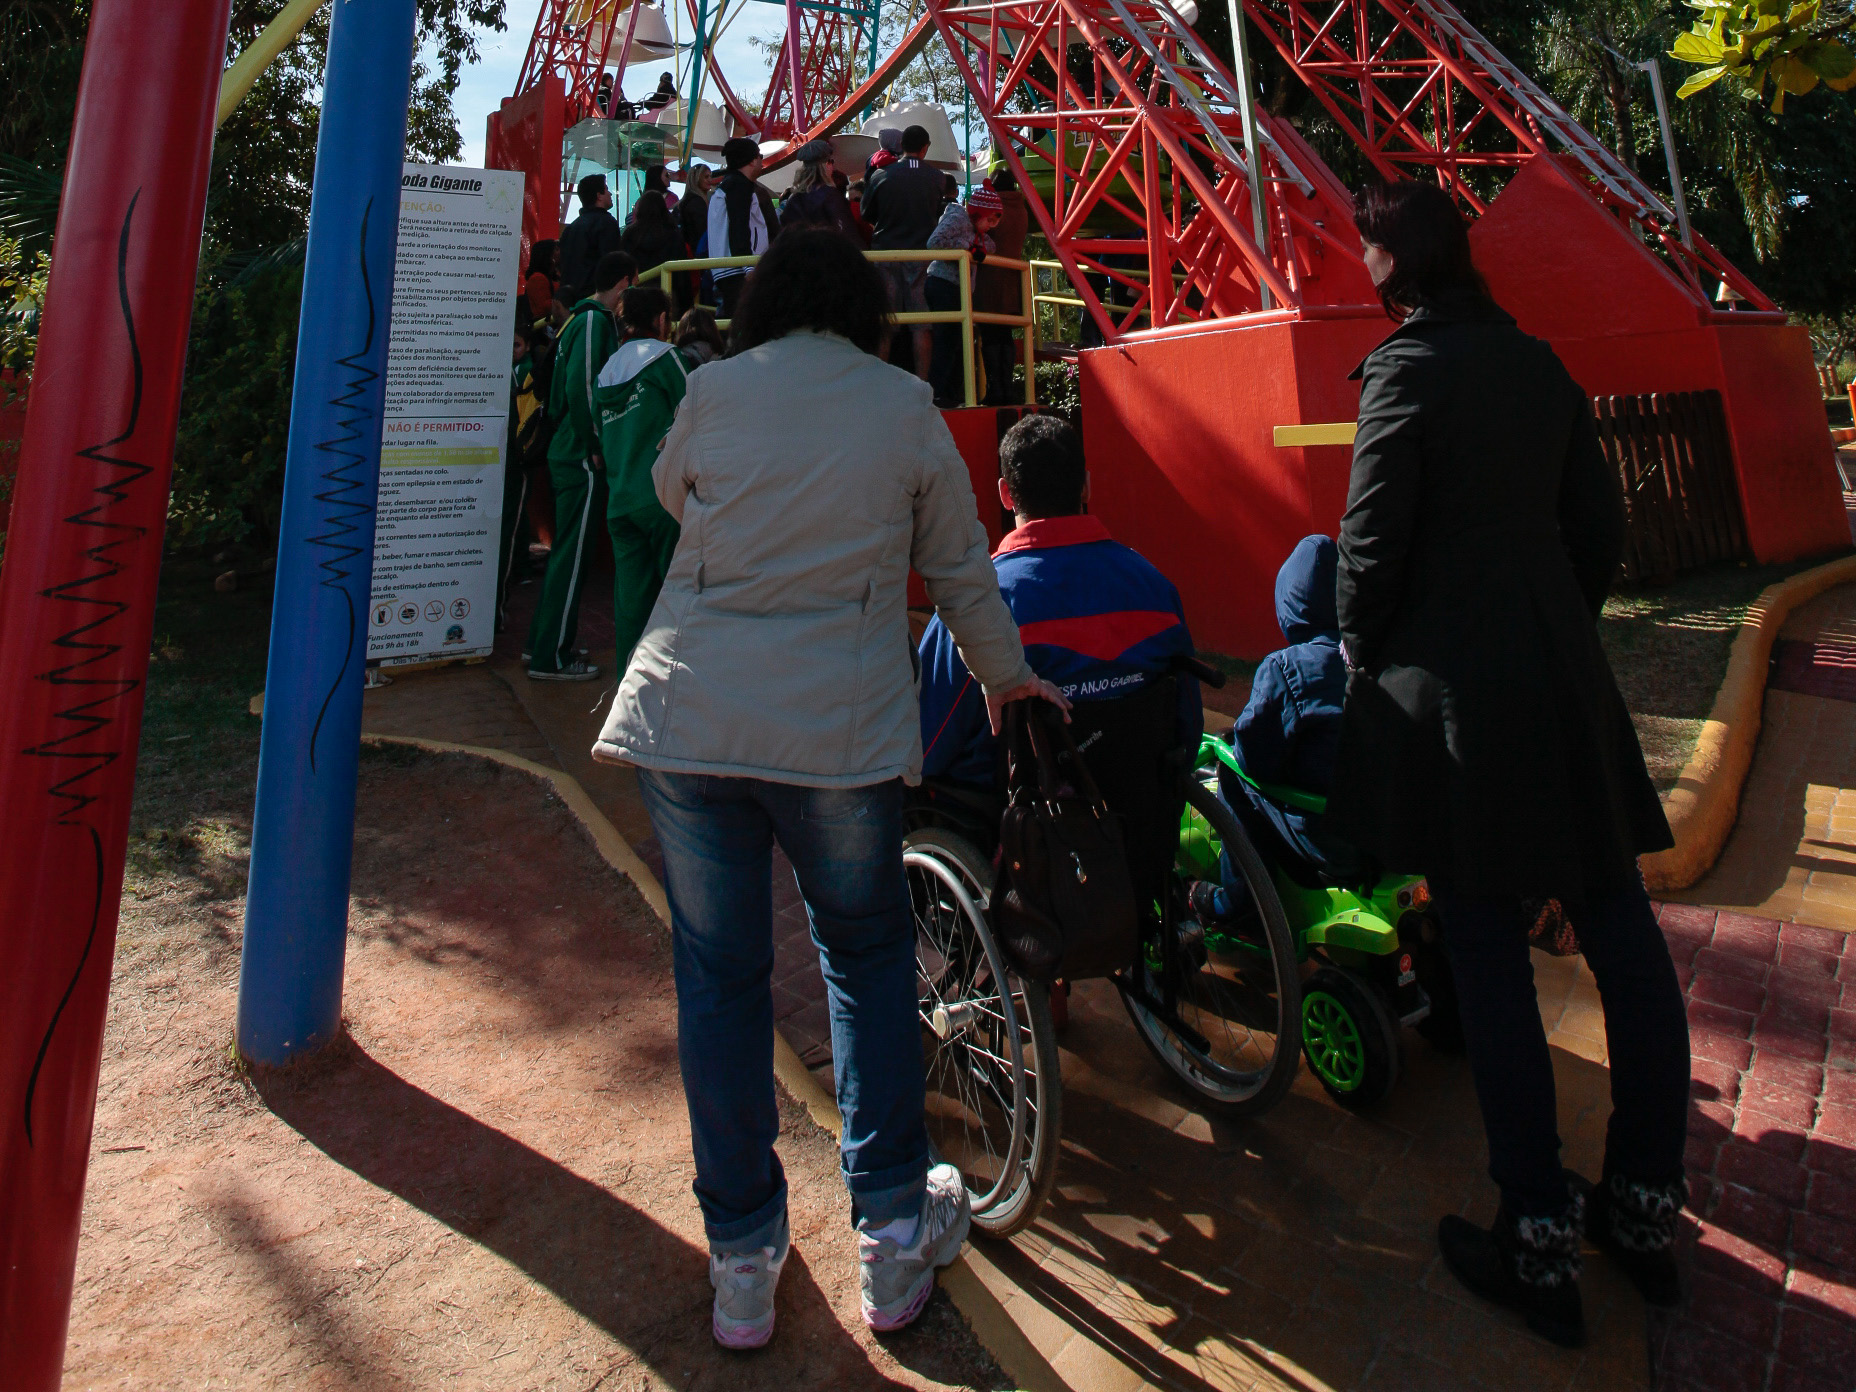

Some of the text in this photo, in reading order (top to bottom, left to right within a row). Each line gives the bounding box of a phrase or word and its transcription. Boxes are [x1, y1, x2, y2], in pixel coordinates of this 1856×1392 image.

[402, 174, 482, 191] oda Gigante
[400, 201, 445, 214] TENÇÃO:
[426, 397, 453, 405] infringir
[387, 421, 484, 432] NÃO É PERMITIDO:
[397, 439, 415, 447] lugar
[394, 498, 436, 506] desembarcar
[389, 507, 407, 515] parte
[386, 513, 418, 521] enquanto
[386, 533, 417, 541] correntes
[394, 564, 412, 572] trajes
[372, 573, 398, 581] escalço.
[1058, 685, 1077, 697] SP
[1080, 678, 1109, 695] ANJO
